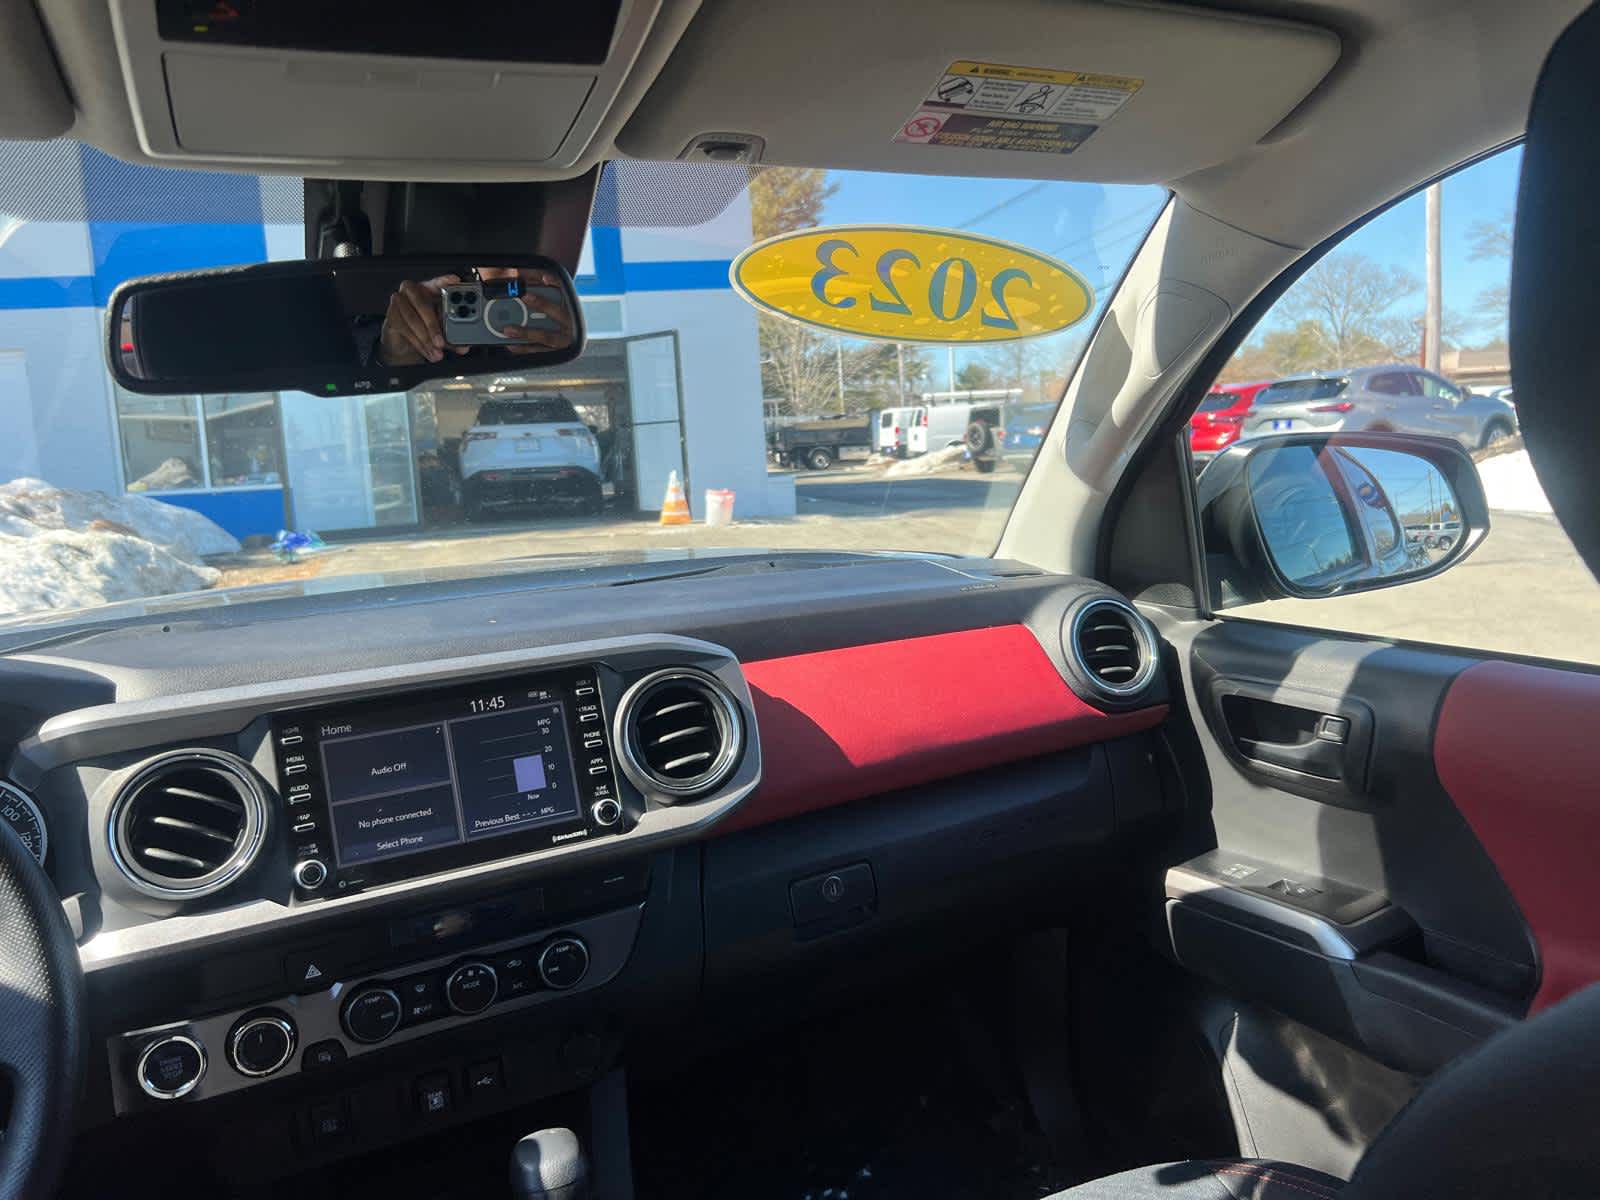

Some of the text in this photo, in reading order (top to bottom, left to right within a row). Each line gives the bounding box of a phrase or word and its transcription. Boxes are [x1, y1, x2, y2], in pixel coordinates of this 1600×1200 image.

[469, 696, 505, 713] 11:45
[537, 718, 551, 727] MPG
[321, 724, 352, 736] Home
[583, 730, 601, 739] PHONE
[544, 745, 553, 753] 20
[371, 762, 407, 776] Audio Off
[290, 784, 309, 793] AUDIO
[1, 806, 20, 822] 100
[358, 808, 432, 829] No phone connected
[474, 815, 505, 828] Previous
[505, 812, 521, 823] Best
[540, 806, 555, 815] MPG
[376, 835, 424, 851] Select Phone
